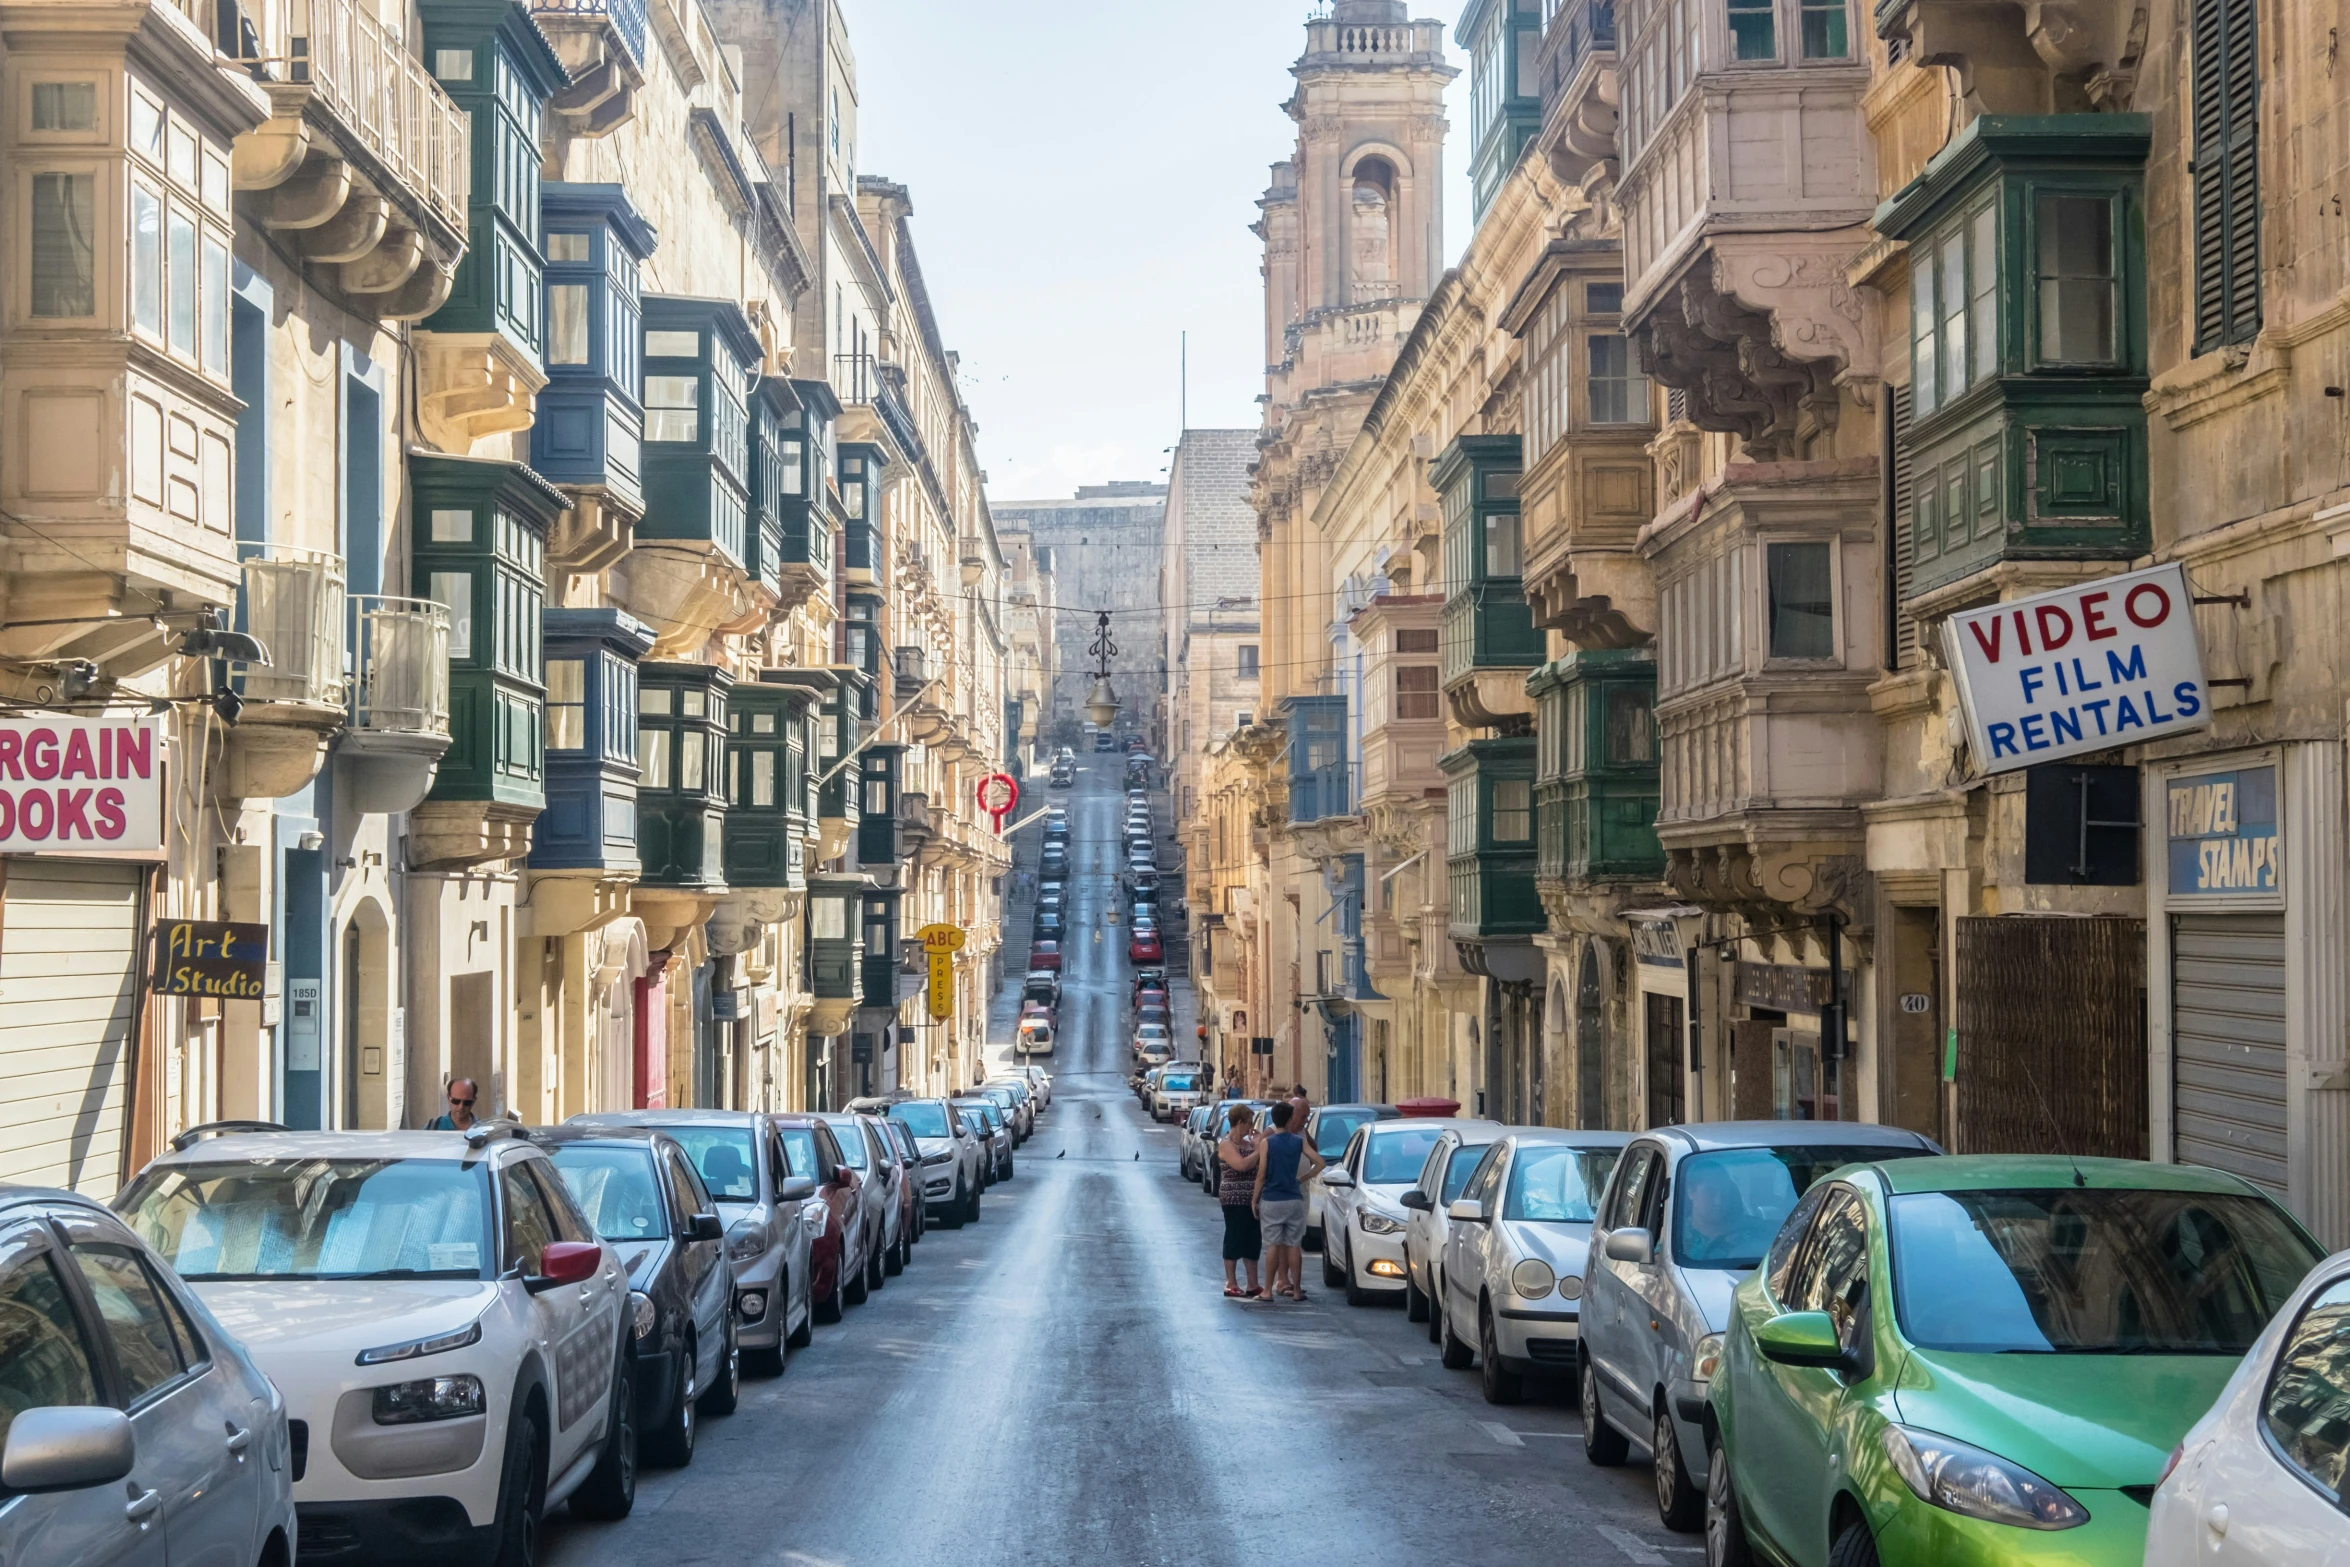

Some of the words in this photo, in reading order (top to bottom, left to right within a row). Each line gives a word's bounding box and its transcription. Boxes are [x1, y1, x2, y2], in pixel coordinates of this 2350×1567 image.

[1969, 582, 2171, 663] VIDEO
[2019, 645, 2147, 704] FILM
[1988, 682, 2200, 758] RENTALS
[2169, 782, 2236, 837] TRAVEL
[2198, 836, 2278, 888] STAMPS
[926, 931, 956, 946] ABC
[174, 966, 262, 997] Studio
[293, 988, 317, 998] 185D
[936, 957, 944, 1012] PRESS
[1904, 995, 1926, 1012] 40
